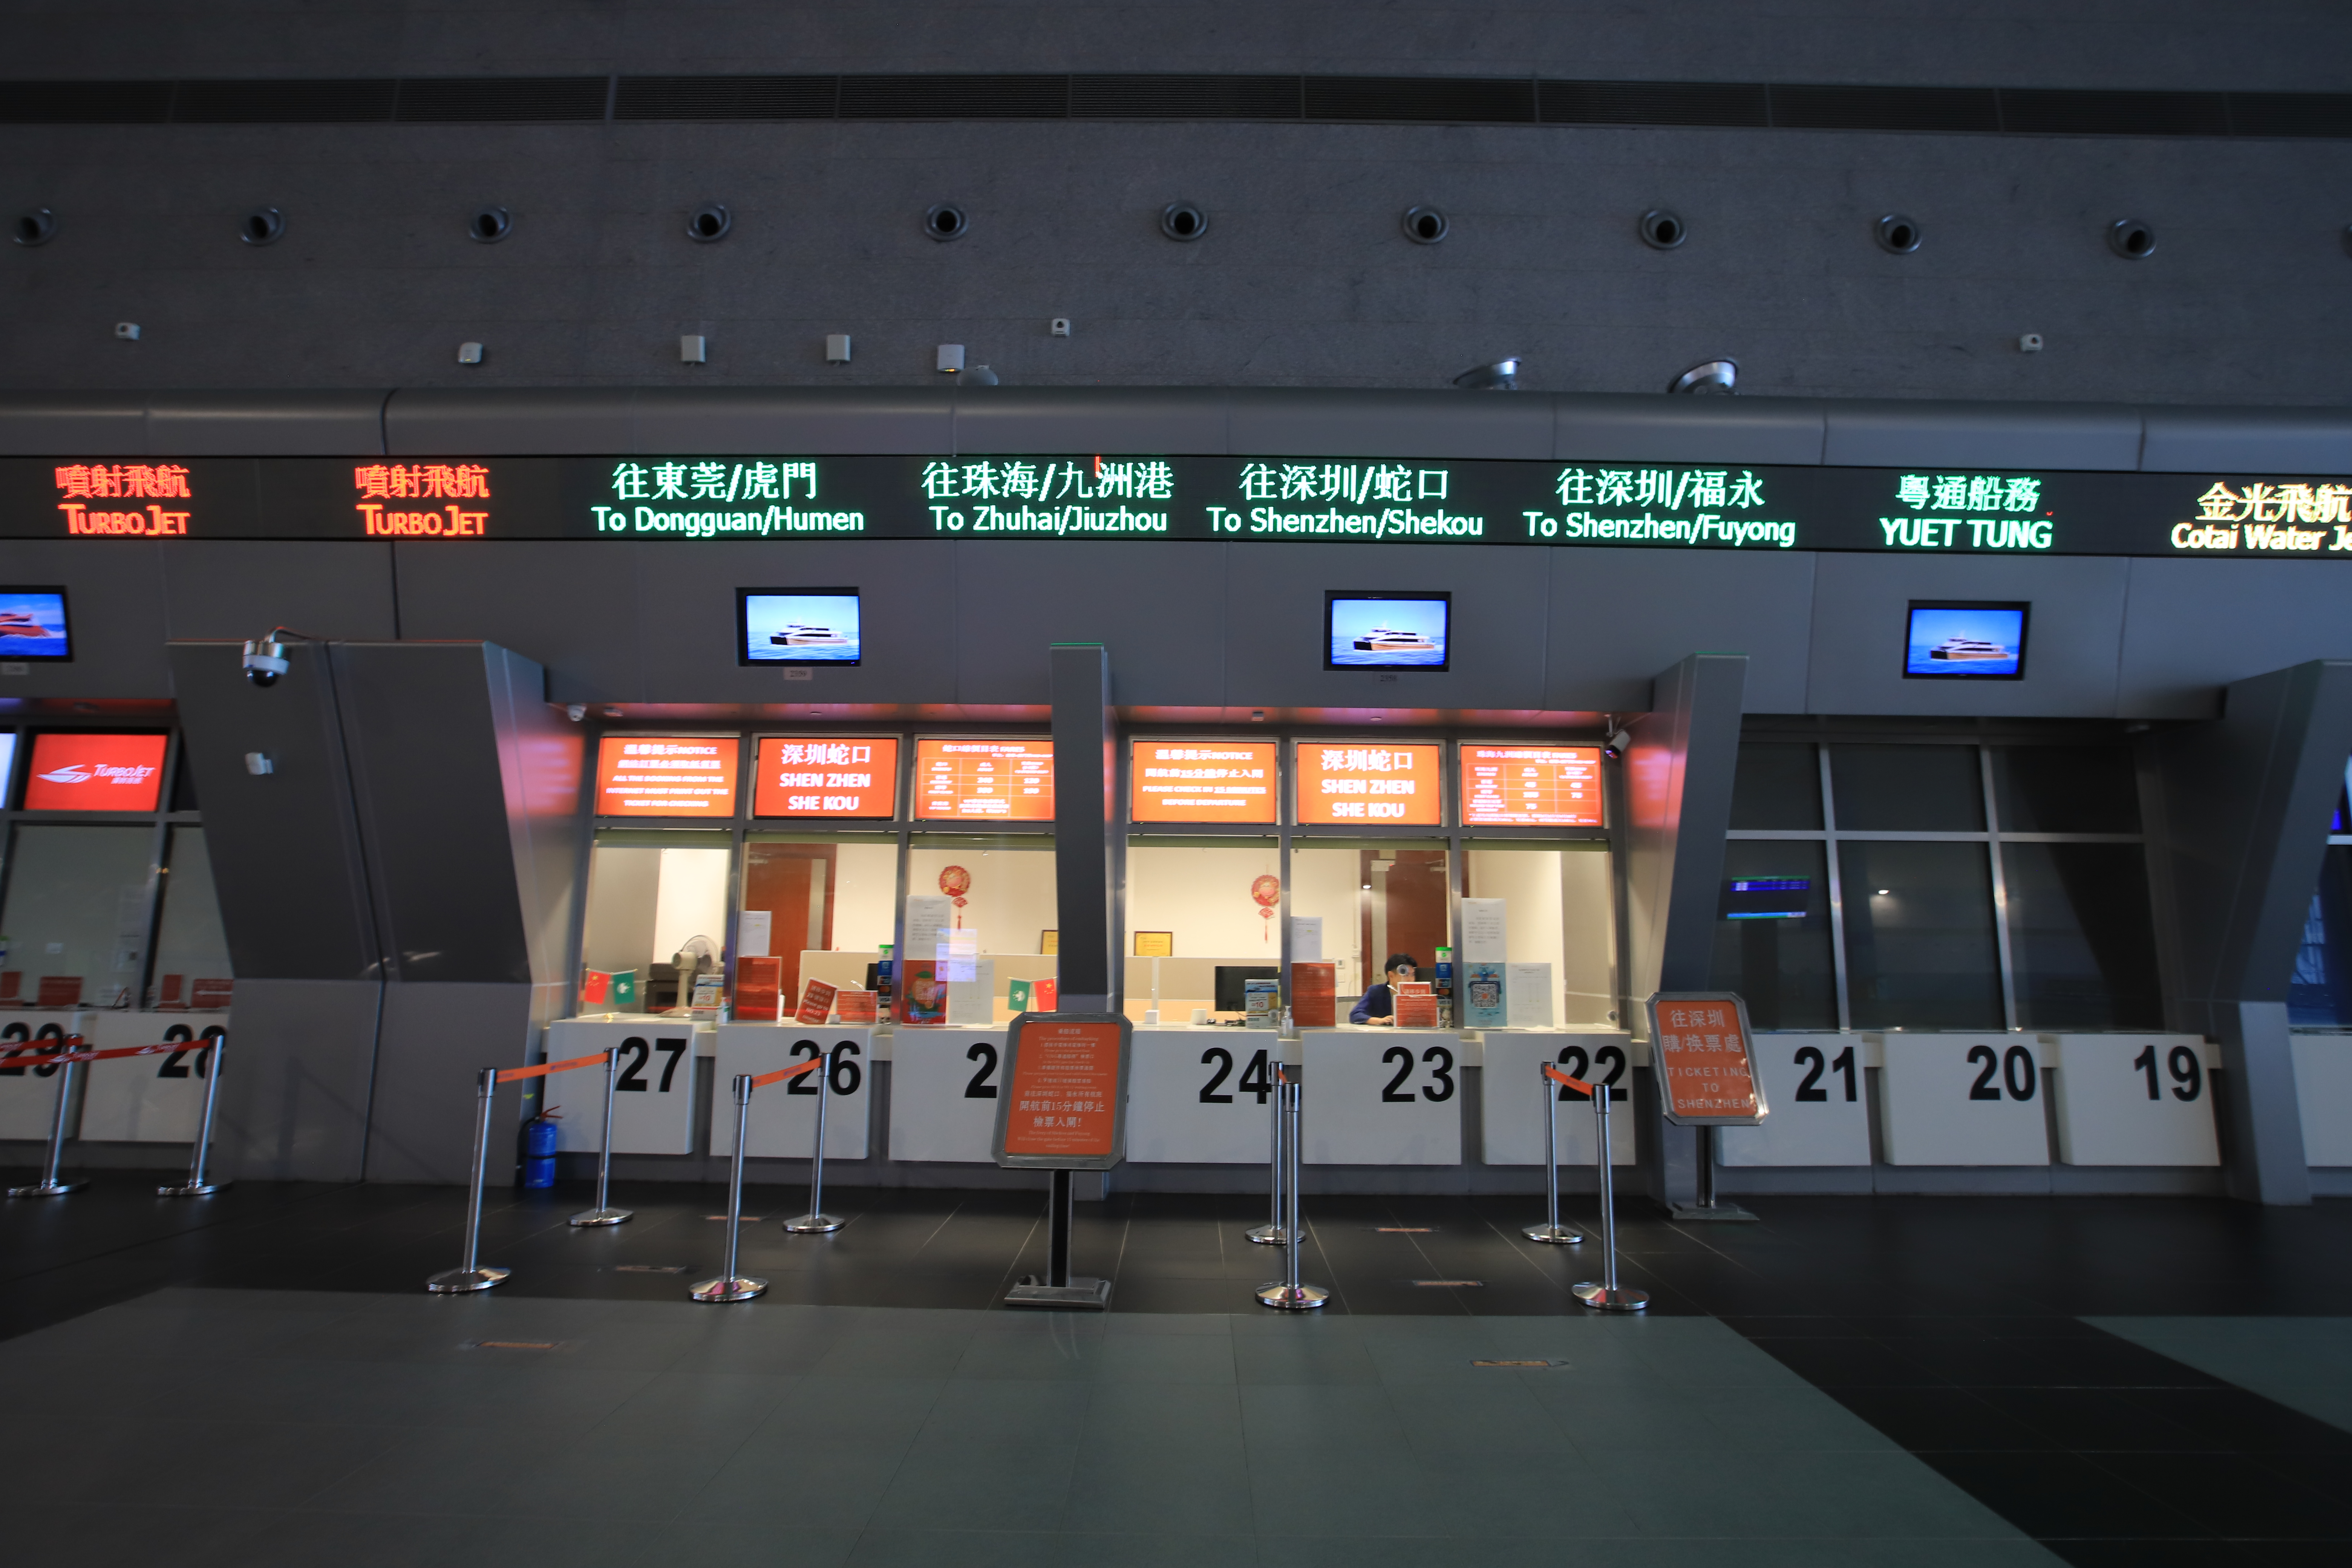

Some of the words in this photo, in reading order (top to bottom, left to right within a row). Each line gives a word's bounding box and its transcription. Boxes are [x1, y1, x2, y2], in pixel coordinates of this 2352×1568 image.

[55, 464, 191, 498] 噴射飛航
[354, 464, 491, 499] 噴射飛航
[612, 461, 816, 502] 往東莞/虎門
[921, 461, 1174, 502] 往珠海/九洲港
[1239, 463, 1448, 504] 往深圳/蛇口
[1556, 468, 1765, 510] 往深圳/福永
[1895, 474, 2041, 512] 粵通船務
[929, 505, 964, 530] To
[974, 505, 1167, 535] Zhuhai/Jiuzhou
[2195, 482, 2352, 523] 金光飛航
[591, 507, 626, 531] To
[635, 505, 864, 537] Dongguan/Humen
[1206, 507, 1241, 531] To
[1251, 507, 1482, 539] Shenzhen/Shekou
[1523, 511, 1557, 536] To
[1566, 511, 1796, 547] Shenzhen/Fuyong
[1879, 518, 1962, 547] YUET
[1966, 519, 2053, 548] TUNG
[2171, 522, 2238, 550] Cotai
[2244, 523, 2326, 550] Water
[781, 744, 871, 765] 深圳蛇口
[1321, 749, 1412, 772] 深圳蛇口
[779, 773, 824, 787] SHEN
[826, 773, 871, 787] ZHEN
[1321, 779, 1367, 794] SHEN
[1369, 779, 1415, 795] ZHEN
[788, 796, 820, 810] SHE
[823, 796, 859, 810] KOU
[1332, 802, 1365, 817] SHE
[1368, 803, 1405, 818] KOU
[1670, 1009, 1726, 1028] 往深圳
[0, 1022, 63, 1077] 29
[616, 1037, 686, 1092] 27
[787, 1040, 861, 1095] 26
[965, 1043, 997, 1098] 2
[1199, 1047, 1272, 1104] 24
[1382, 1046, 1454, 1102] 23
[1558, 1046, 1628, 1101] 22
[1667, 1067, 1748, 1076] TICKETING
[1794, 1046, 1857, 1101] 21
[1967, 1045, 2035, 1101] 20
[2134, 1045, 2203, 1101] 19
[1678, 1098, 1749, 1109] SHENZHEN
[1702, 1083, 1719, 1092] TO
[1019, 1101, 1105, 1112] 開航前15分鐘停止
